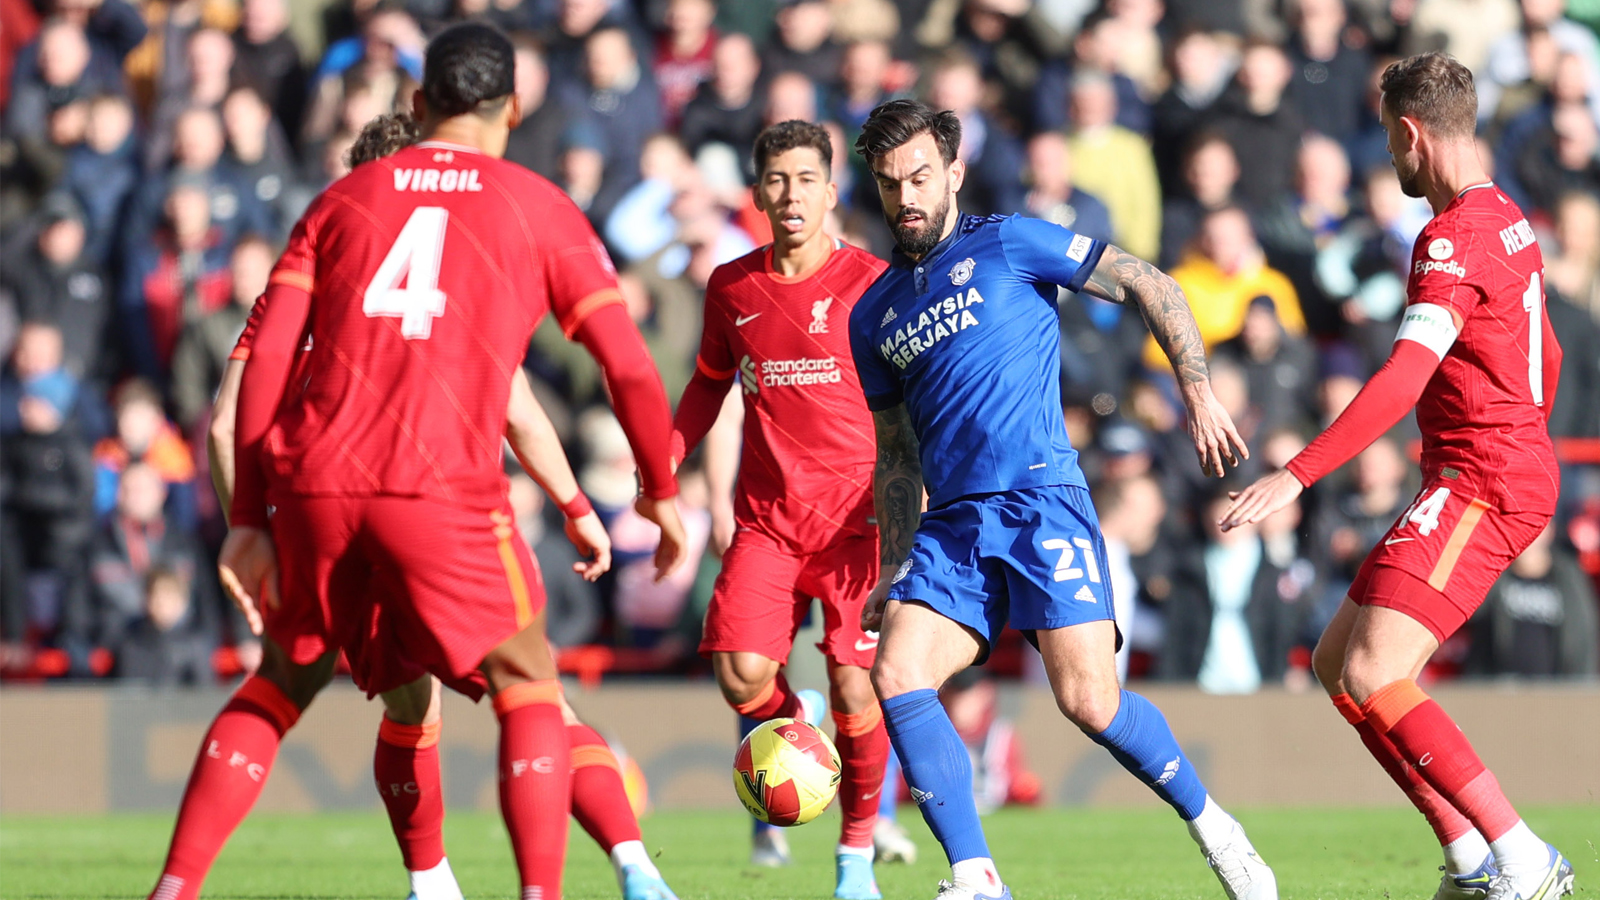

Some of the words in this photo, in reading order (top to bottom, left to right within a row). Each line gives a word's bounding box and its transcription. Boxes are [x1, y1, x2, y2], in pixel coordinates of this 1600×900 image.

[393, 168, 483, 192] VIRGIL
[362, 206, 449, 340] 4
[1415, 260, 1466, 278] Expedia
[808, 322, 829, 334] LFC
[880, 287, 984, 360] MALAYSIA
[892, 310, 979, 369] BERJAYA
[1522, 268, 1545, 407] 1
[761, 357, 835, 373] standard
[763, 369, 841, 386] chartered
[1041, 537, 1100, 583] 21
